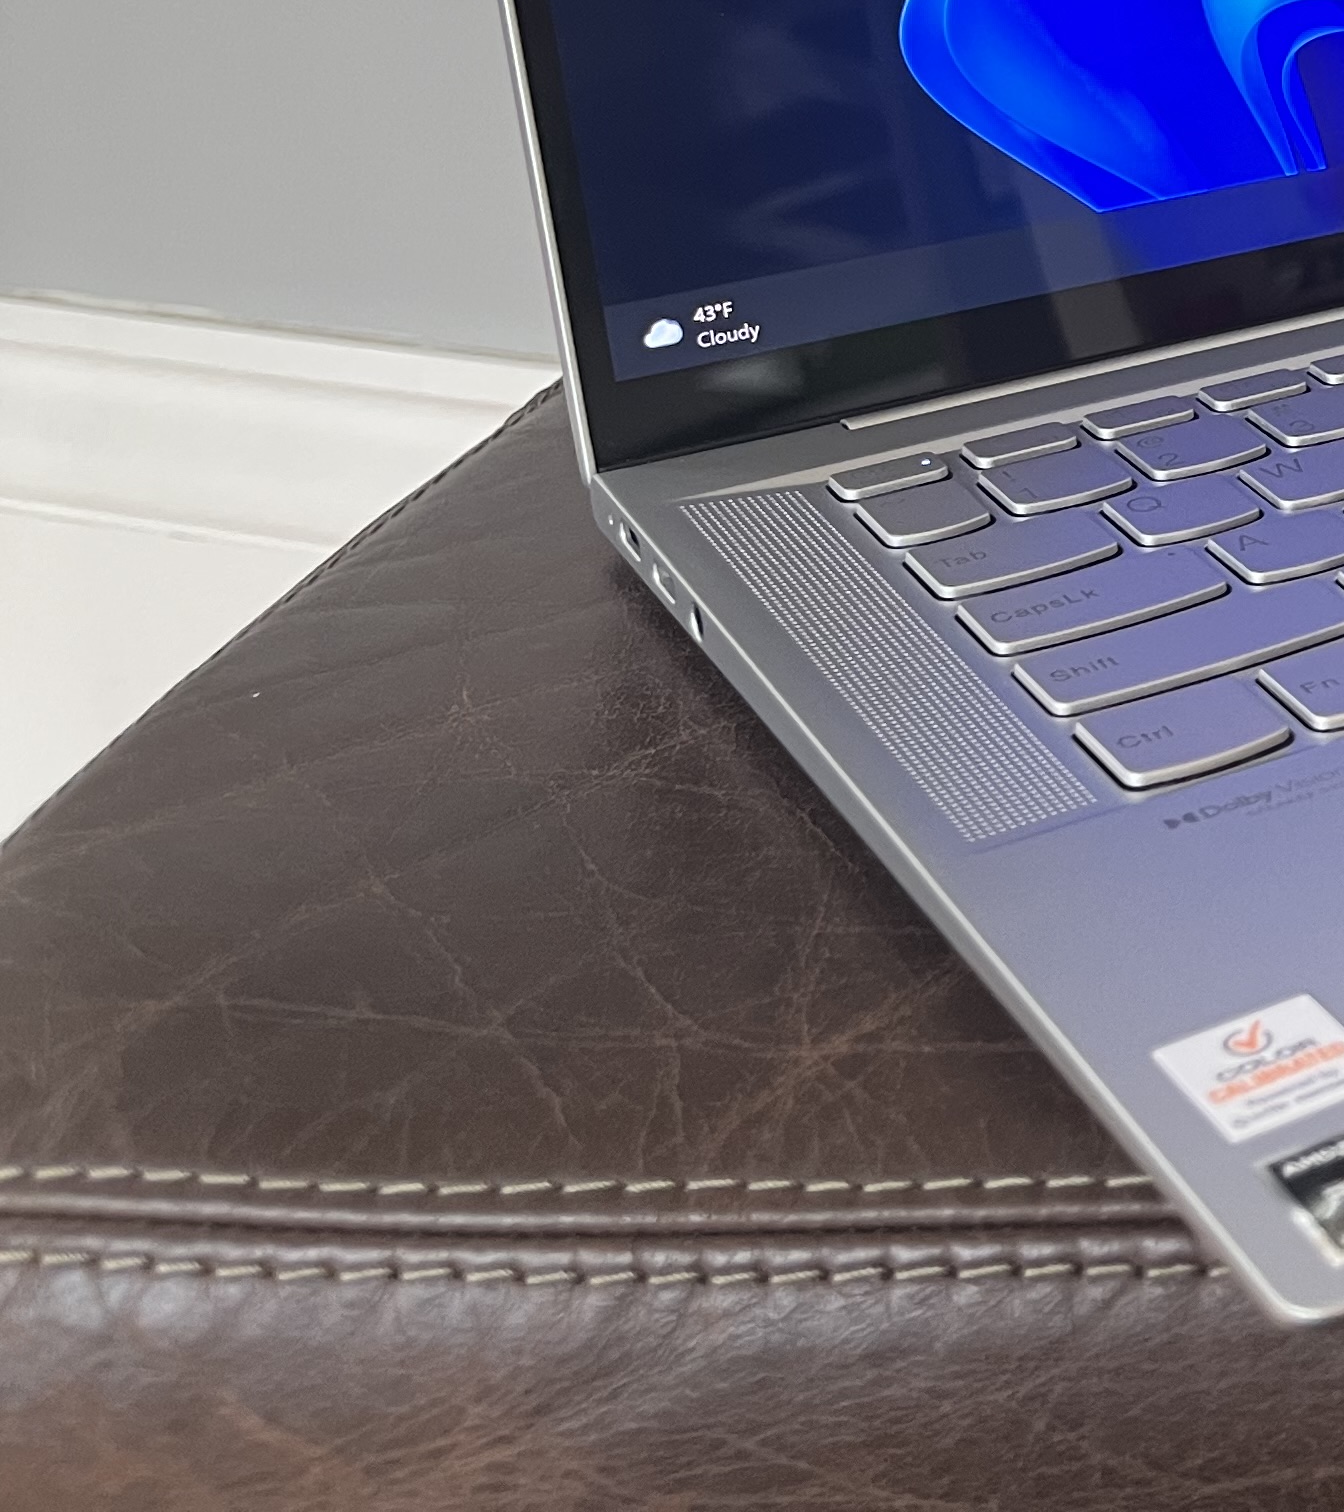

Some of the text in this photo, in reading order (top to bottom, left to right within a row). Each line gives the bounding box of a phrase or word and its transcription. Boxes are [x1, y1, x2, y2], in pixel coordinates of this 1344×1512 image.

[693, 301, 733, 322] 43°F
[697, 322, 760, 348] Cloudy
[1157, 452, 1186, 468] 2
[1259, 457, 1303, 479] W
[1125, 495, 1167, 514] Q
[1237, 533, 1269, 551] A
[936, 549, 986, 569] Tab
[989, 588, 1100, 624] CapsLk
[1048, 655, 1121, 684] Shift
[1299, 678, 1341, 694] Fn
[1115, 724, 1175, 750] Ctrl
[1199, 790, 1272, 818] Dolby
